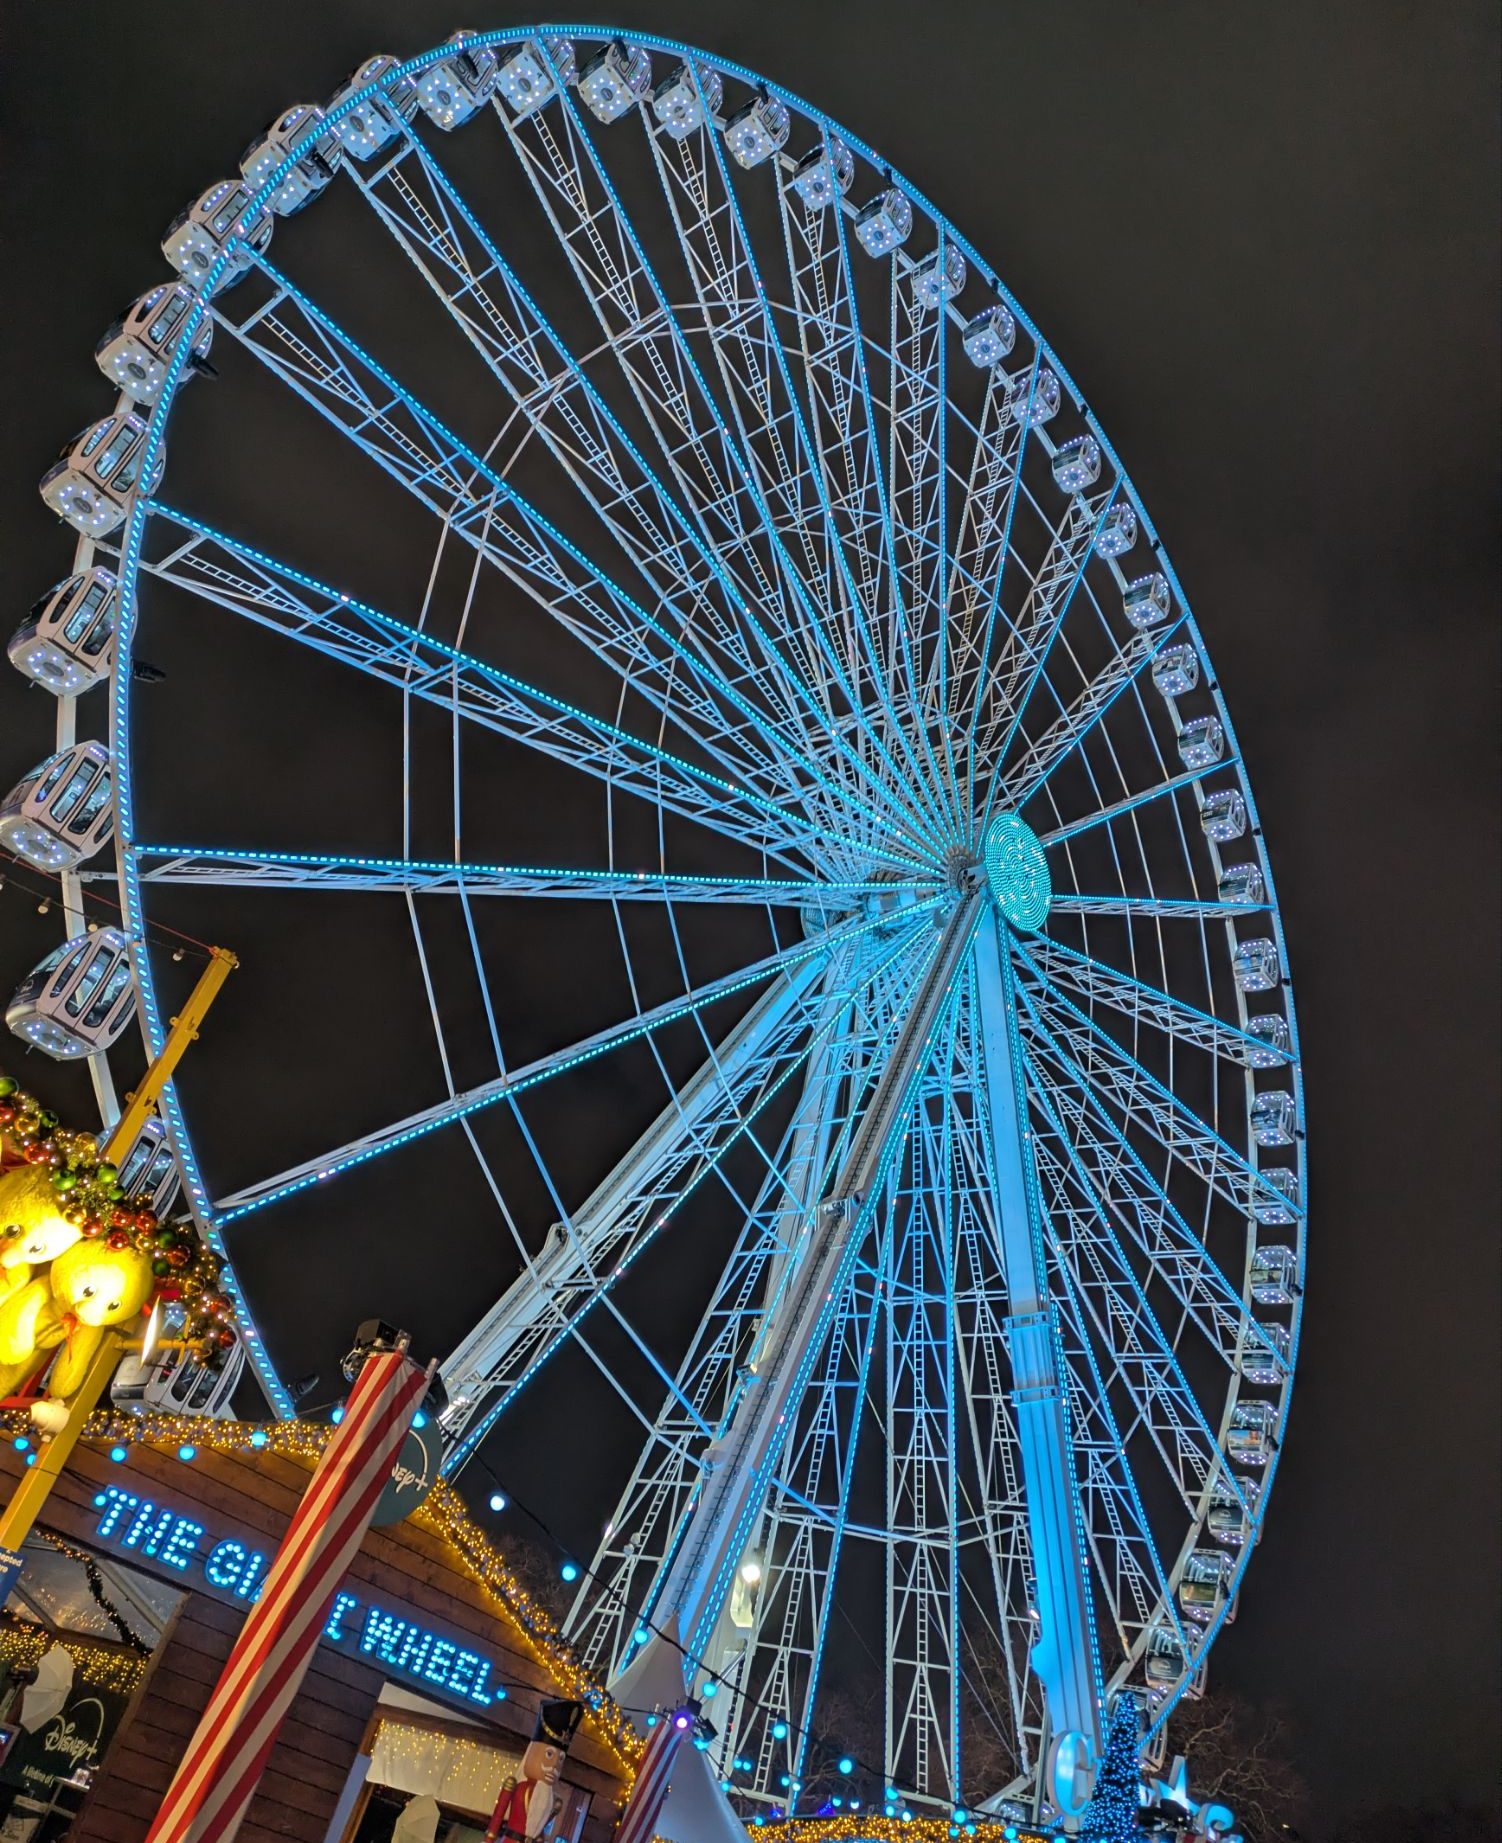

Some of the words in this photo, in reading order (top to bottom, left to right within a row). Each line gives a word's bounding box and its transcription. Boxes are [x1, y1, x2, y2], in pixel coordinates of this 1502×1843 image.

[96, 1484, 206, 1571] THE
[205, 1538, 358, 1641] GIT
[360, 1605, 493, 1707] WHEEL
[45, 1712, 99, 1769] Disney+
